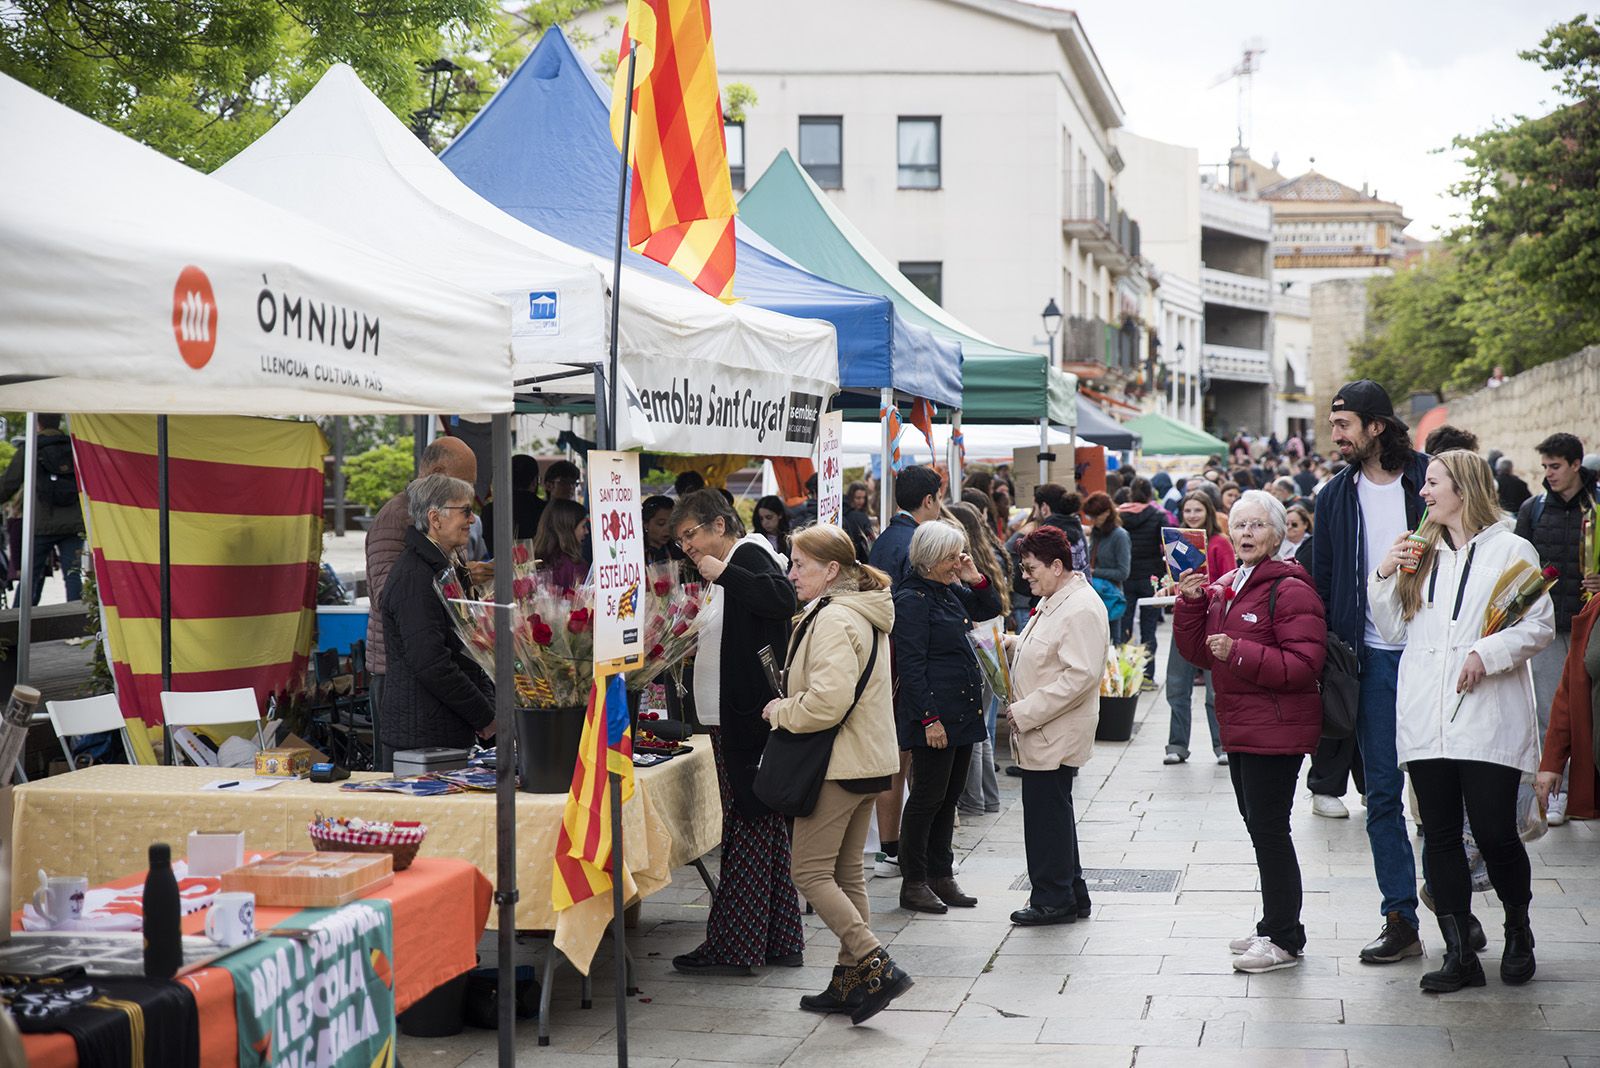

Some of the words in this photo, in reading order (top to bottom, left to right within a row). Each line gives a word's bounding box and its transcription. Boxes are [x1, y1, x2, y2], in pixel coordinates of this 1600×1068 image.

[257, 273, 380, 357] ÒMNIUM
[261, 355, 309, 379] LLENGUA
[314, 364, 360, 387] CULTURA
[637, 377, 702, 426] emblea
[706, 384, 741, 429] Sant
[742, 388, 786, 443] Cugat
[611, 471, 621, 485] Per
[599, 488, 614, 502] SANT
[615, 488, 633, 502] JORDI
[599, 562, 641, 590] ESTELADA
[606, 595, 617, 617] 5€
